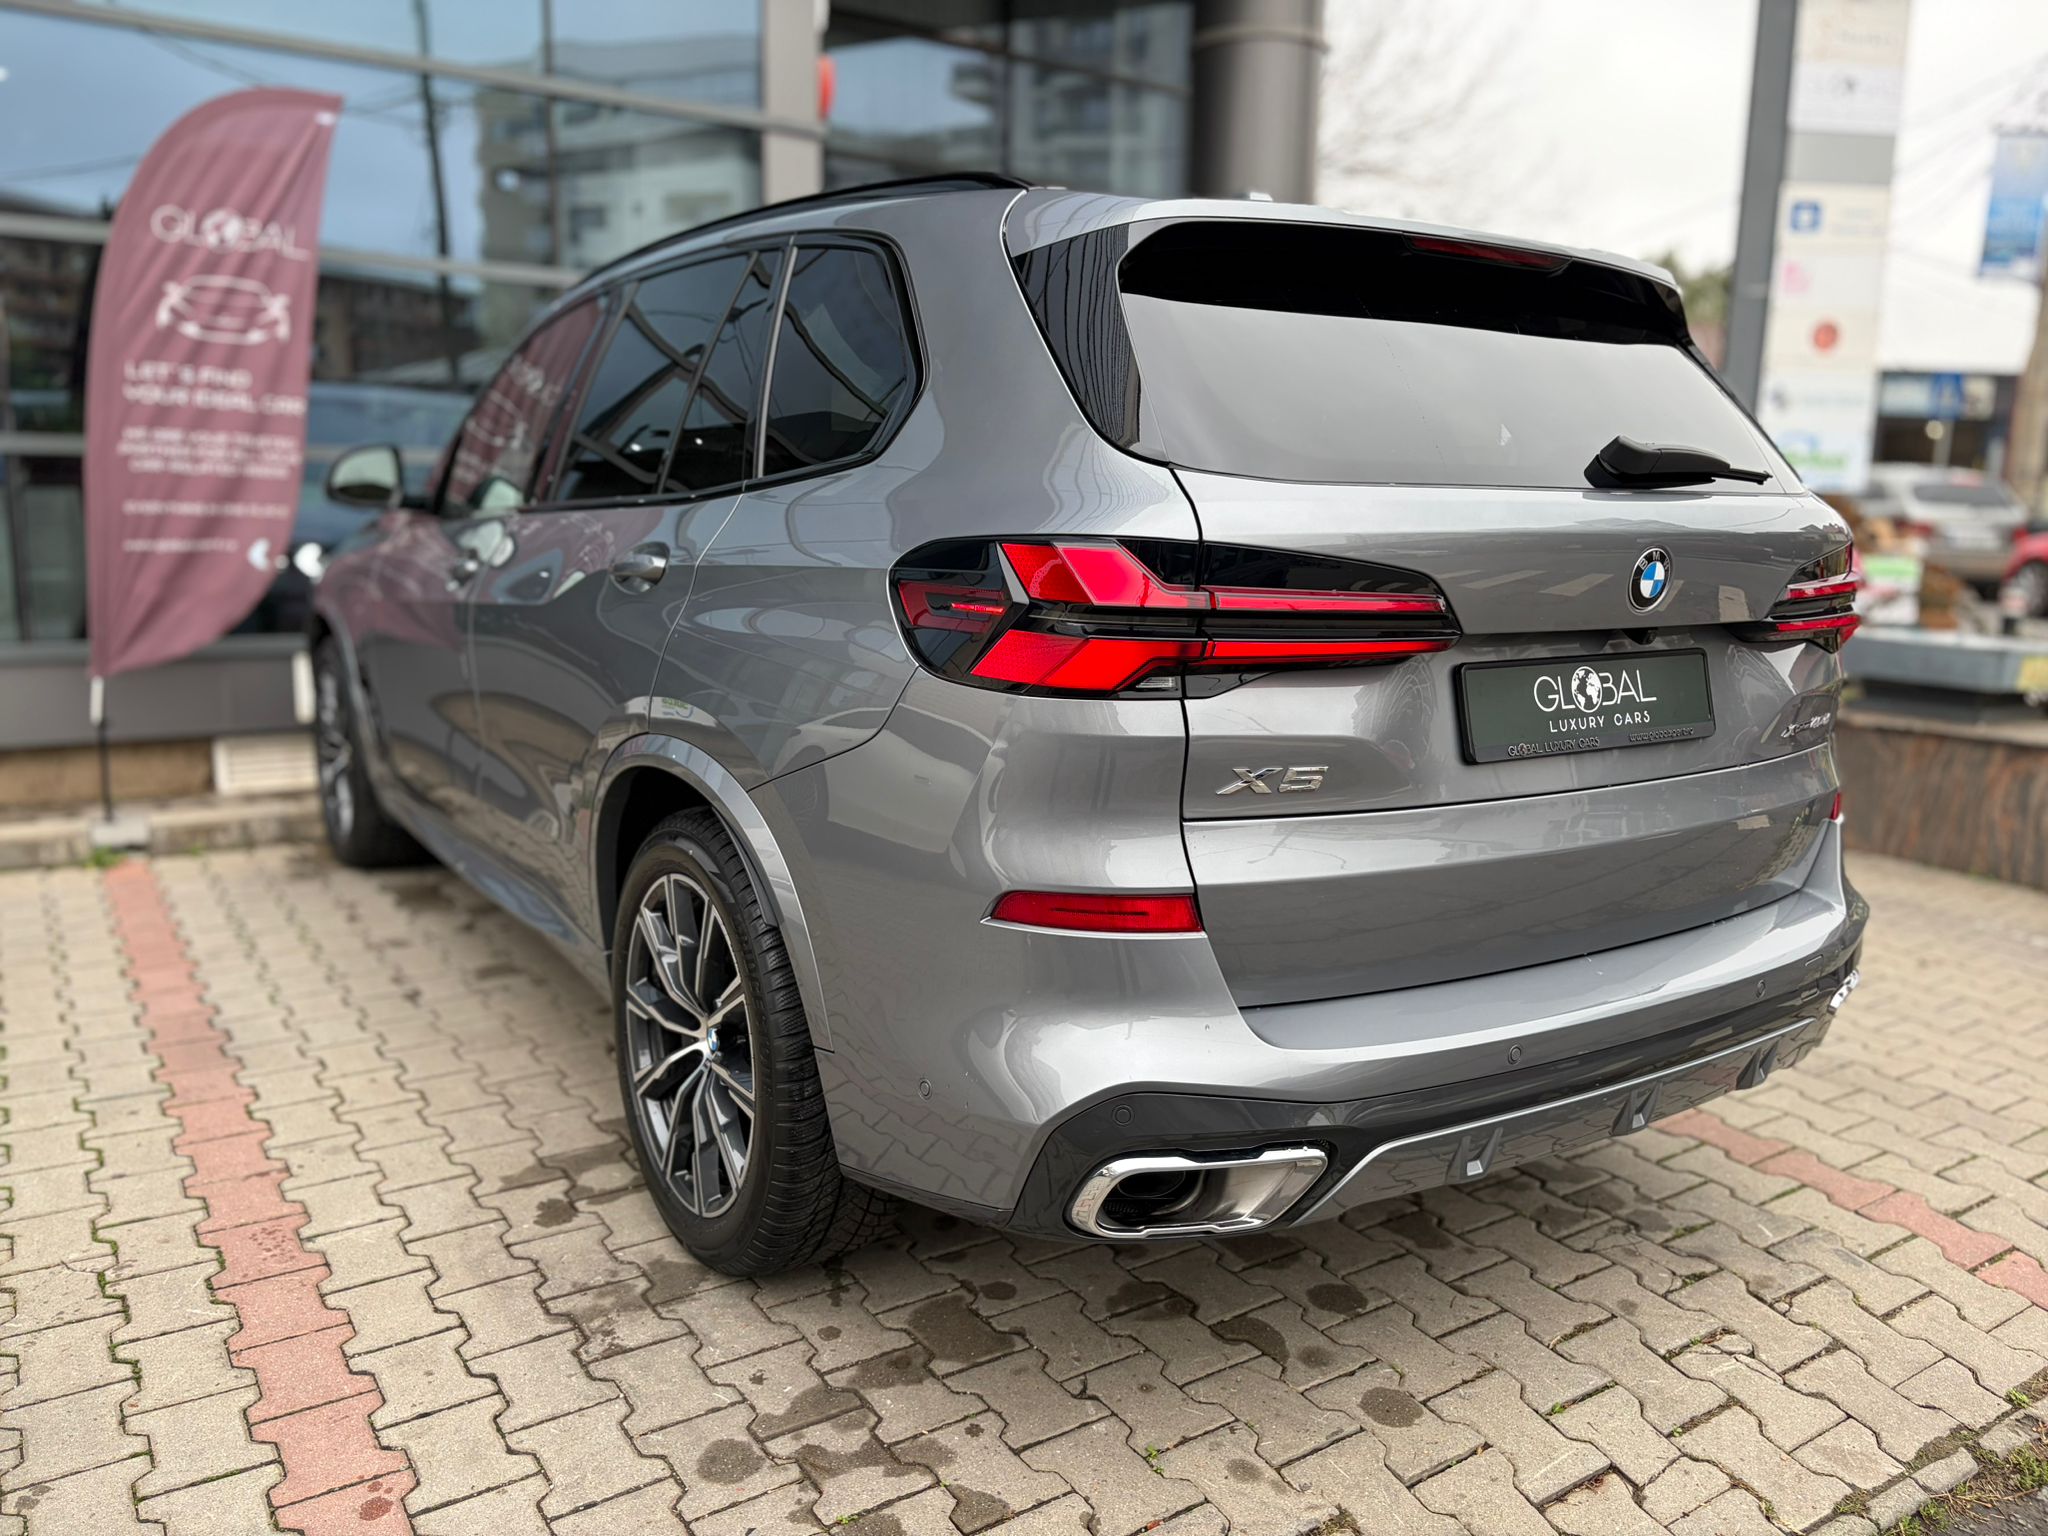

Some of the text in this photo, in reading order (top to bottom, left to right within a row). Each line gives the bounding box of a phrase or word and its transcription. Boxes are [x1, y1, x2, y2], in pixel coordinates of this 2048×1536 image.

[150, 204, 310, 261] GLOBAL
[1533, 666, 1657, 713] GLOBAL
[1549, 710, 1651, 733] LUXURY CARS
[1507, 736, 1601, 757] GLOBAL LUXURY CARS
[1216, 766, 1329, 794] X5
